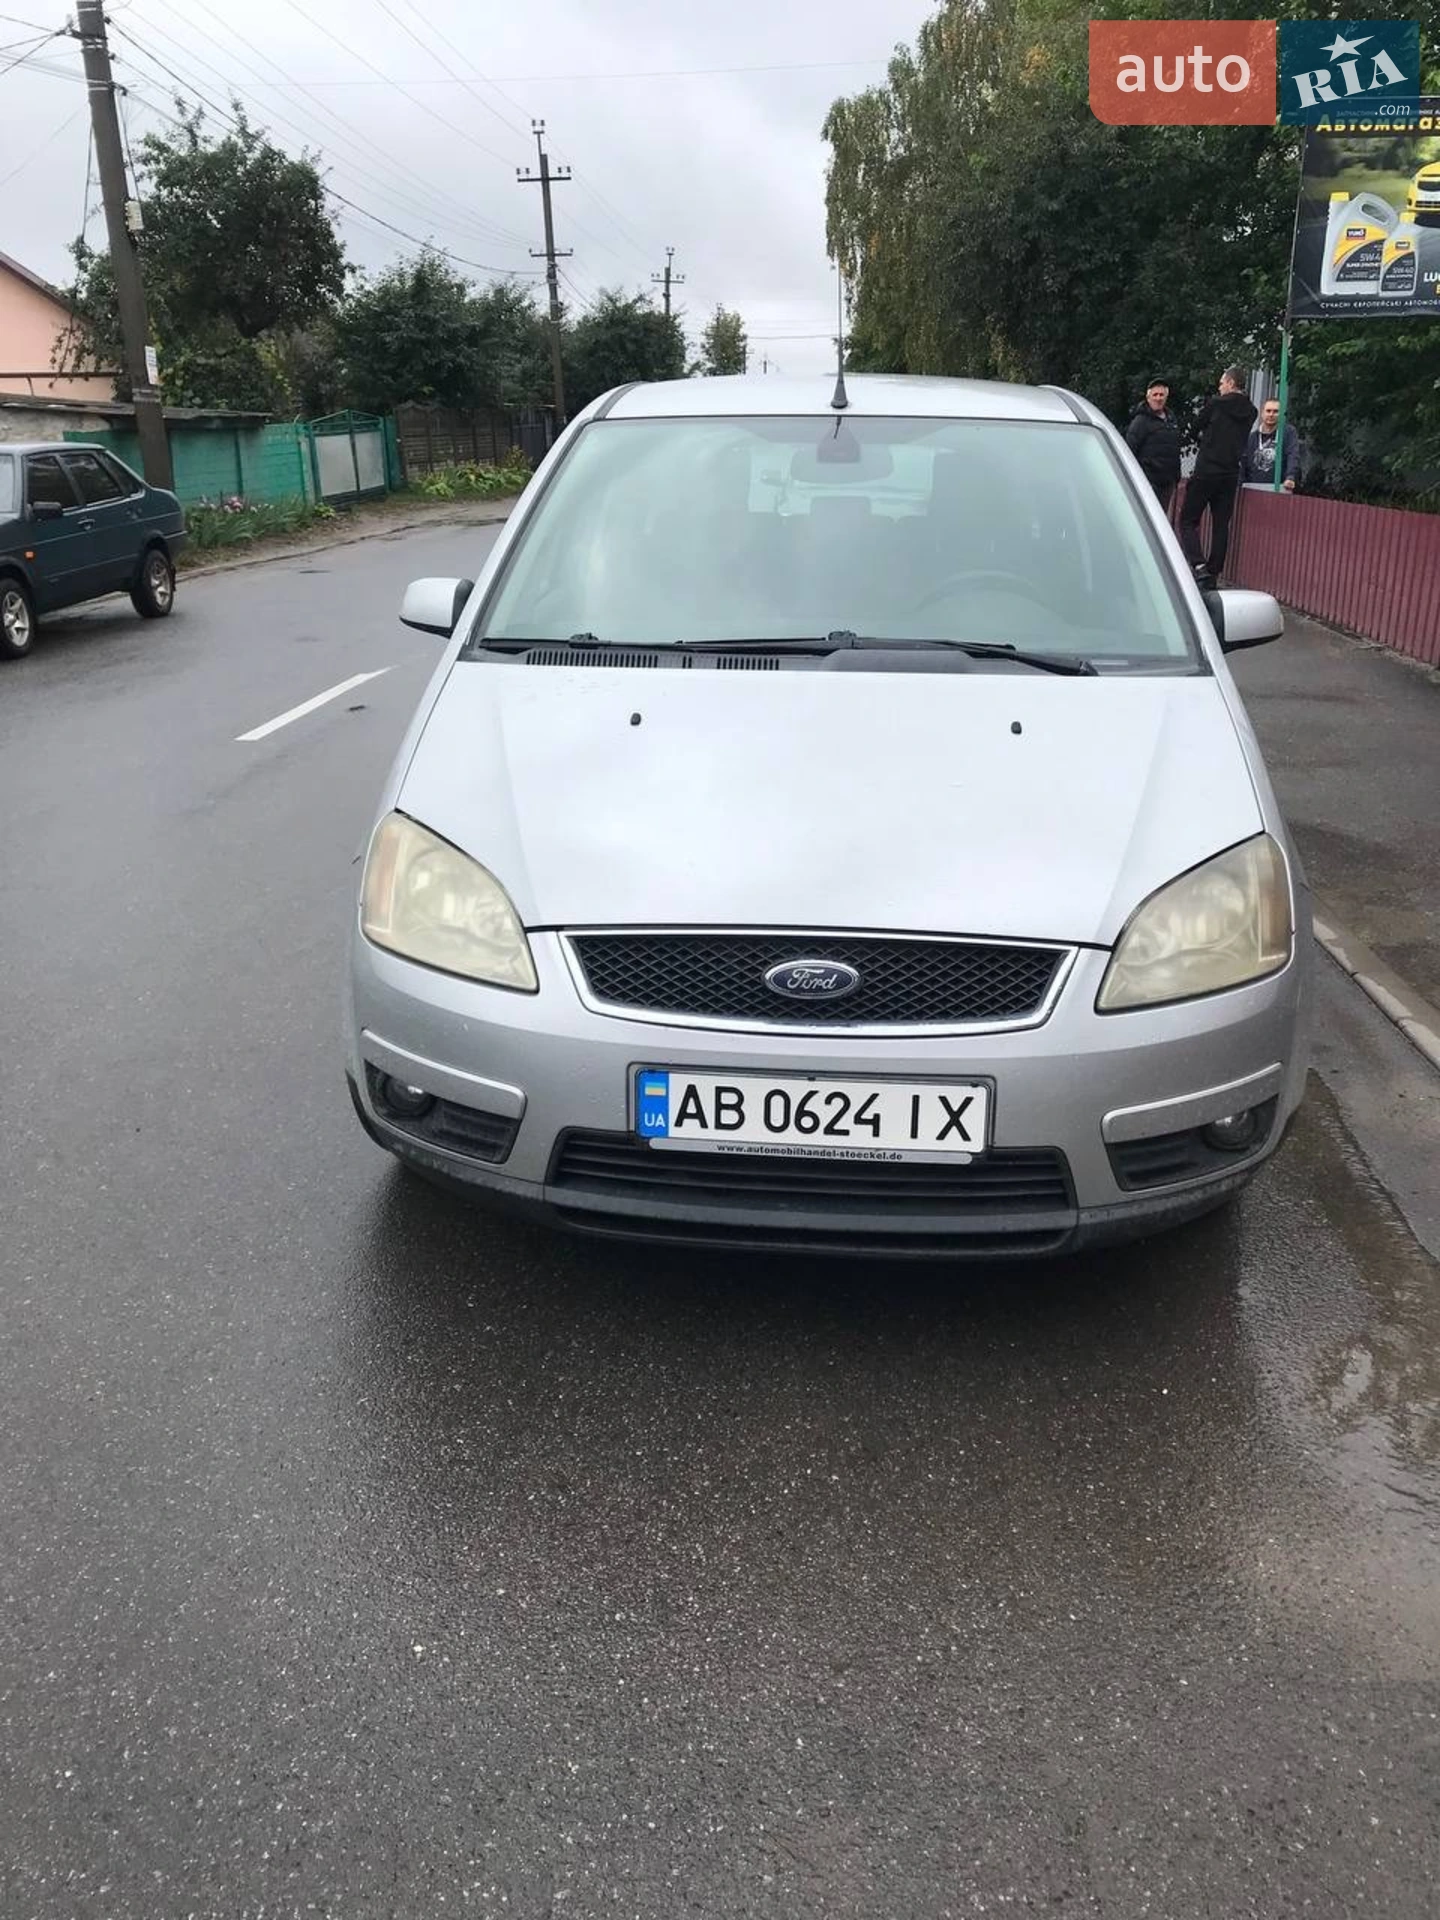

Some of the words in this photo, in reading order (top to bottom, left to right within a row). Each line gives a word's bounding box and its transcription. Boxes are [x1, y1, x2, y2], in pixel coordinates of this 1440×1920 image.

[787, 968, 838, 990] Ford
[674, 1083, 746, 1131] AB
[763, 1088, 881, 1138] 0624
[644, 1113, 666, 1129] UA
[717, 1143, 903, 1162] www.automobilhandel-stoeckel.de
